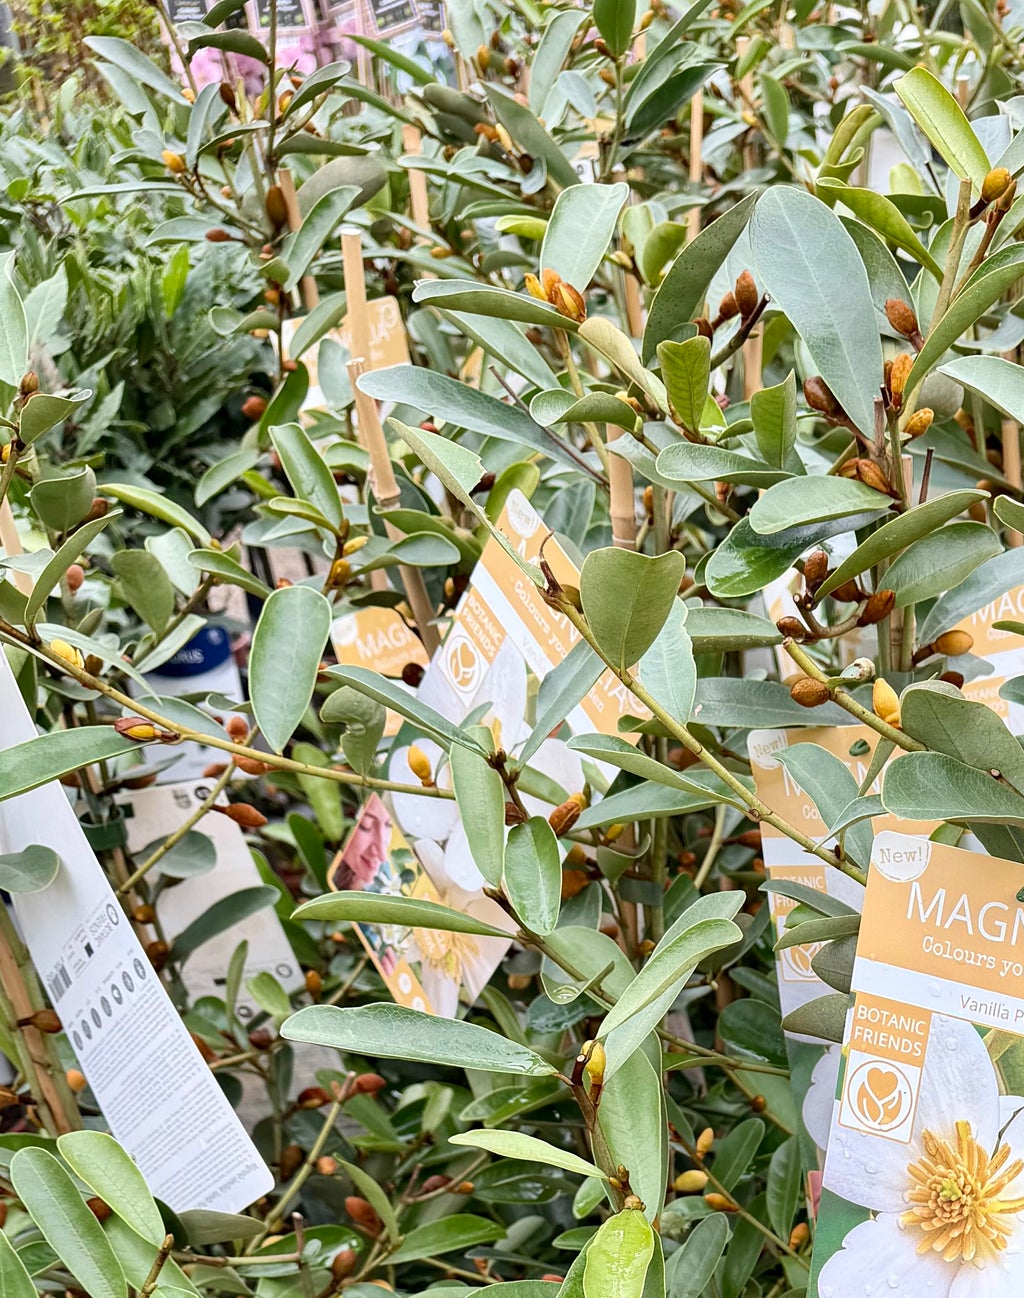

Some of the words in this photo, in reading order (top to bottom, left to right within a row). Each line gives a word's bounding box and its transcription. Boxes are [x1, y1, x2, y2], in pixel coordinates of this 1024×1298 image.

[468, 595, 501, 646] BOTANIC
[514, 580, 551, 635] Colours
[462, 608, 497, 658] FRIENDS
[880, 842, 923, 865] New!
[922, 935, 996, 970] Colours
[856, 1004, 927, 1036] BOTANIC
[960, 993, 1010, 1021] Vanilla
[854, 1025, 923, 1057] FRIENDS
